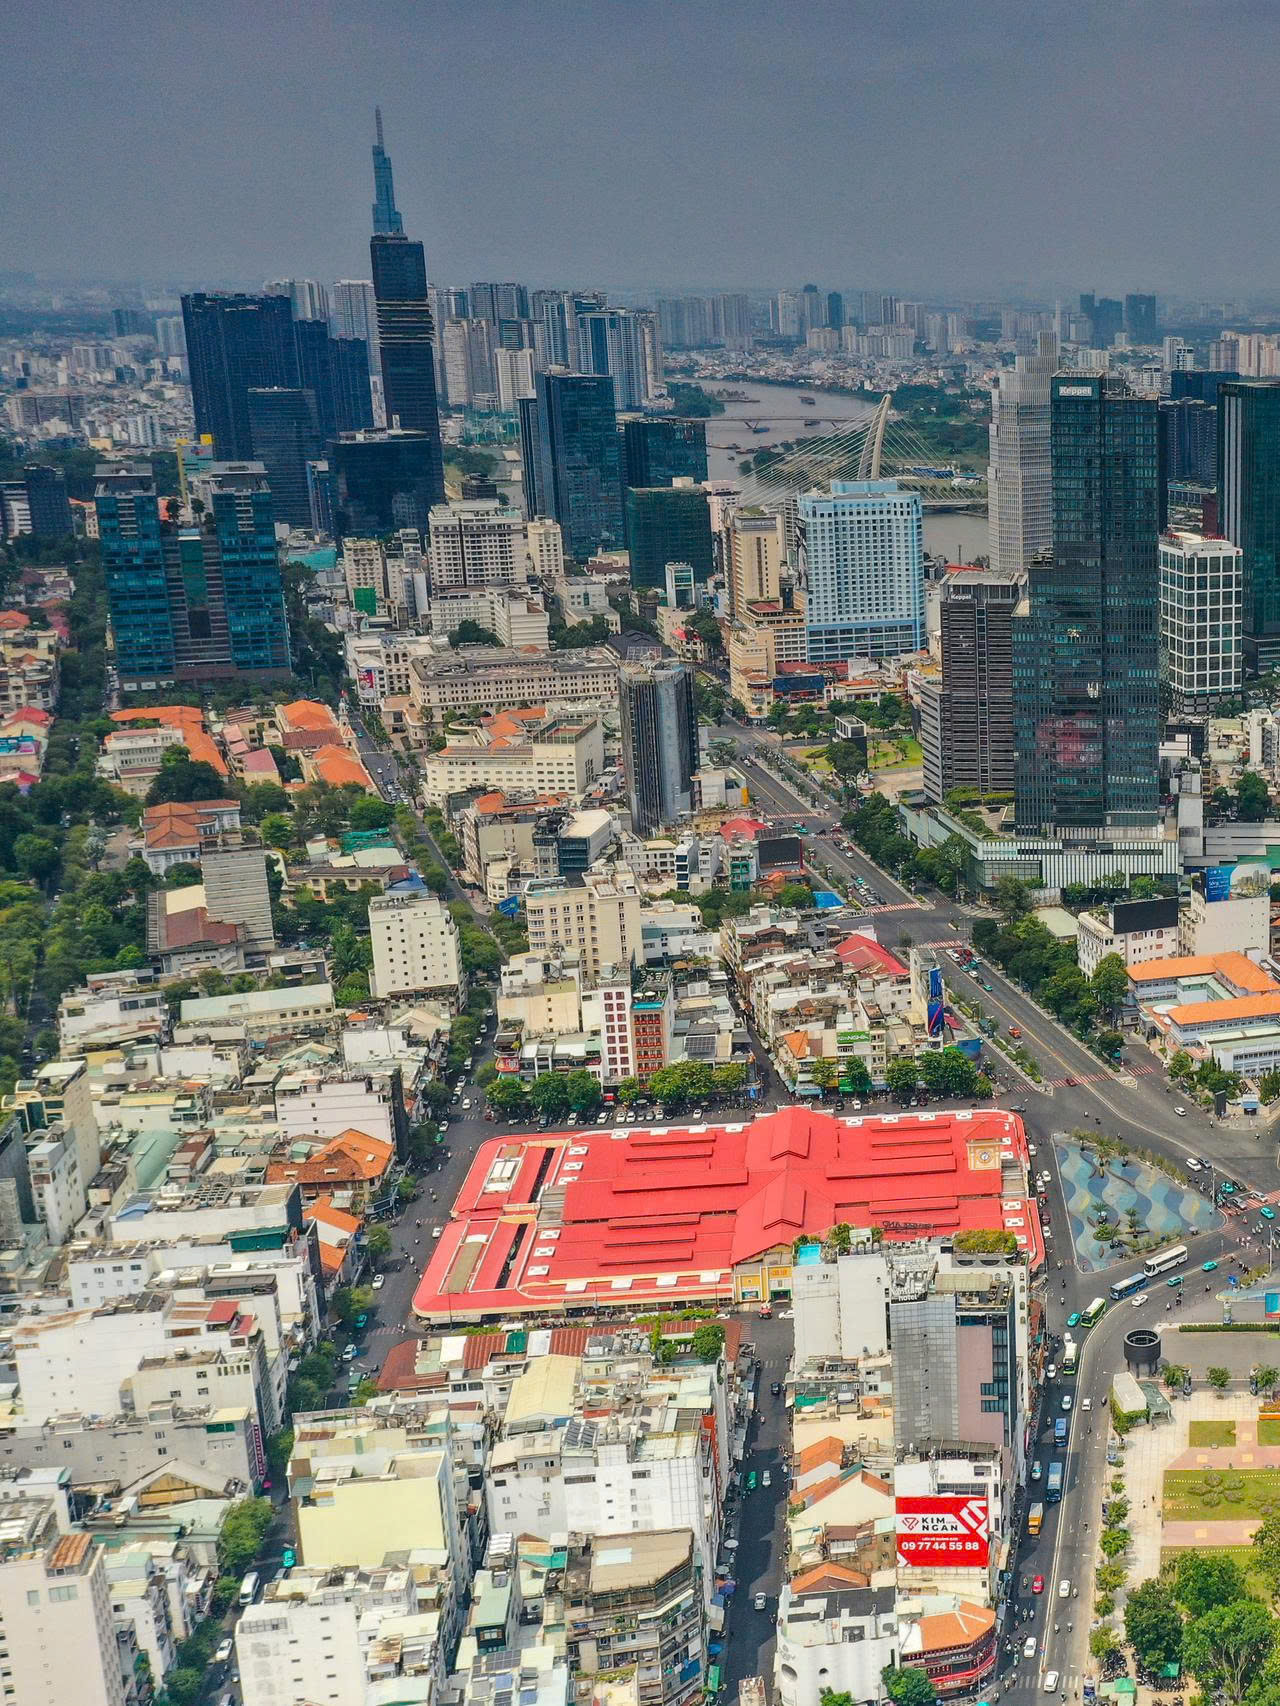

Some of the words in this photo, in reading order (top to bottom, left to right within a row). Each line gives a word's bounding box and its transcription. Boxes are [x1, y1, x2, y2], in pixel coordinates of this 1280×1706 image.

[1060, 386, 1091, 396] Keppel
[901, 1541, 916, 1551] 09
[917, 1541, 931, 1551] 77
[932, 1541, 947, 1551] 44
[949, 1541, 963, 1551] 55
[965, 1541, 979, 1551] 88
